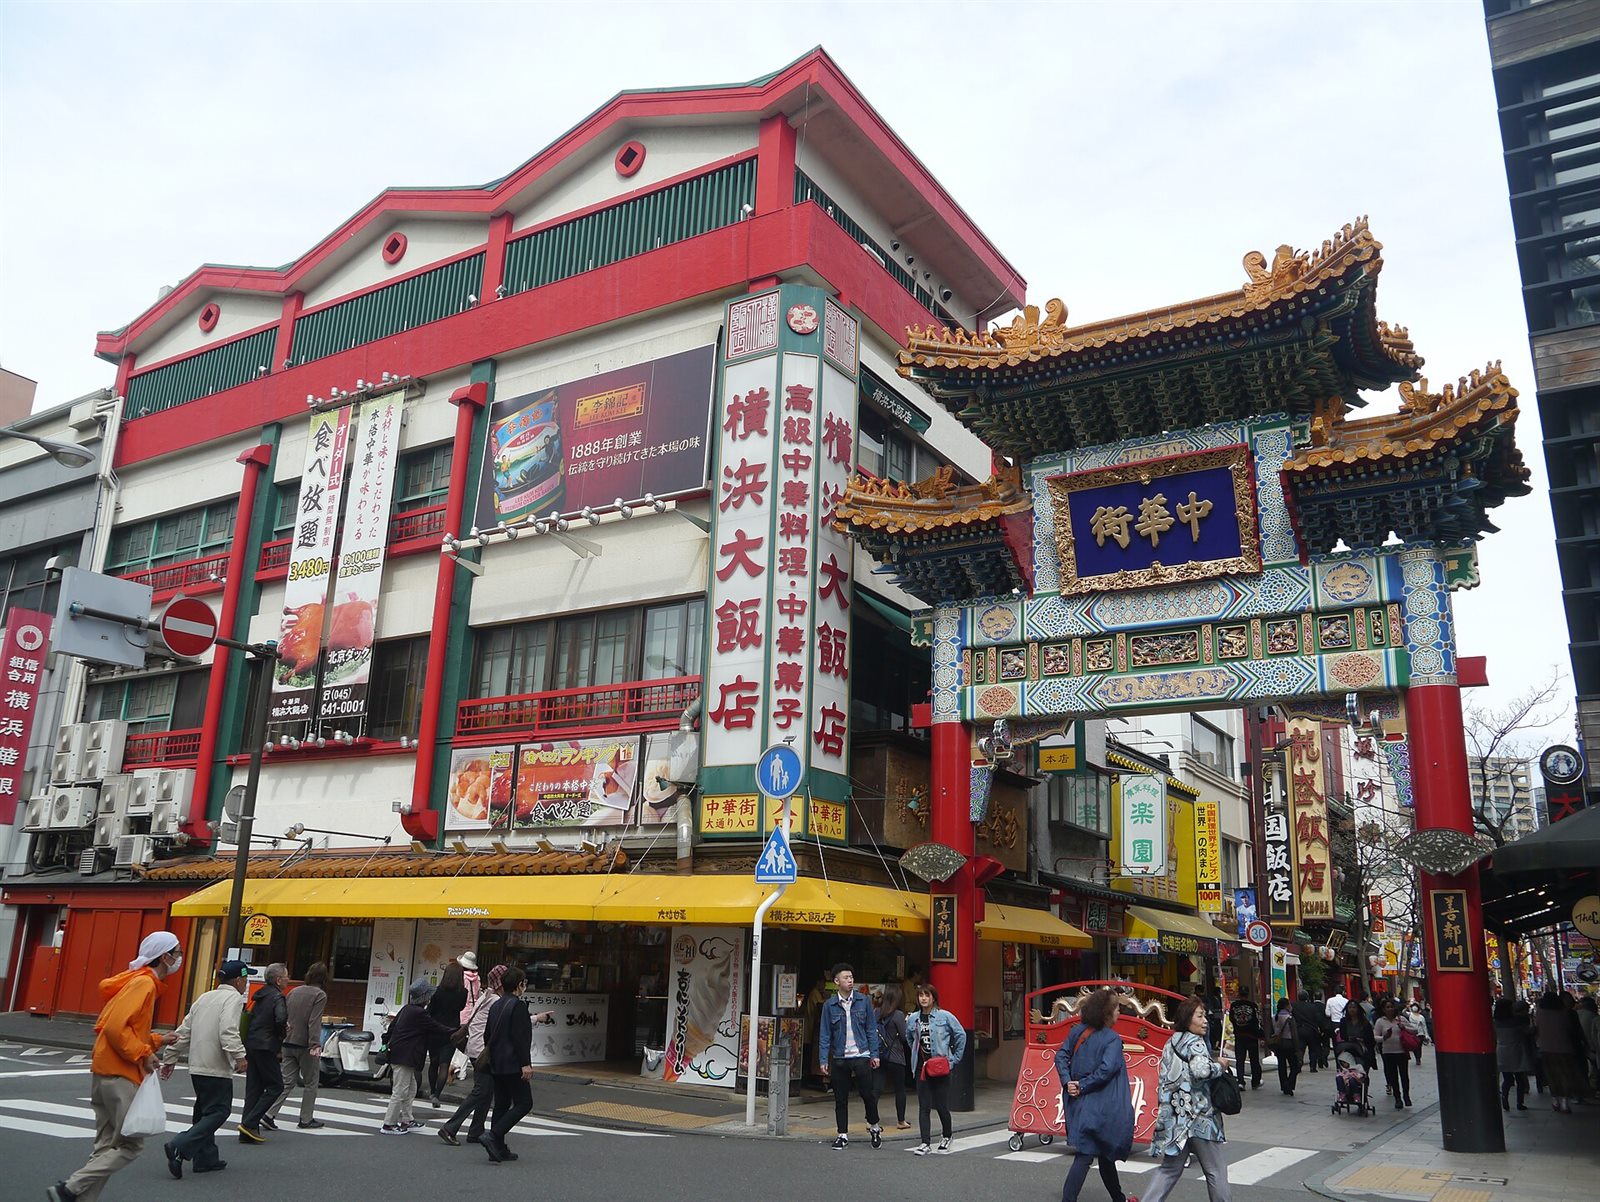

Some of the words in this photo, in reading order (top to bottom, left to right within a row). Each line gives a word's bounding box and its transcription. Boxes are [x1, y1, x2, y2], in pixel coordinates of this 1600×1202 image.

[872, 388, 912, 424] 横浜大飯店
[329, 424, 347, 487] オーダー式
[567, 436, 701, 475] 伝統を守り続けてきた本場の味
[571, 430, 642, 460] 1888年創業
[297, 420, 334, 549] 食べ放題
[354, 408, 380, 541] 本格中華が味わえる
[368, 404, 394, 539] 素材と味にこだわった
[1089, 491, 1214, 549] 中華街
[288, 556, 330, 582] 3,480円
[708, 386, 770, 731] 横浜大飯店
[772, 383, 813, 729] 高級中華料理・中華菓子
[328, 647, 370, 665] 北京ダック
[321, 700, 365, 716] 641-0001
[1045, 754, 1069, 765] 本店
[531, 800, 592, 821] 食べ放題
[706, 798, 756, 816] 中華街
[810, 801, 842, 825] 中華街
[705, 818, 755, 829] 大通り入口
[809, 821, 842, 835] 大通り入口
[1130, 801, 1155, 862] 楽園
[1197, 806, 1208, 879] 世界一の肉まん
[1206, 803, 1218, 881] 中国料理世界チャンピオン
[1199, 891, 1220, 901] 100円
[222, 906, 254, 915] 横飯店
[769, 909, 836, 924] 横浜大飯店
[1162, 935, 1198, 953] 中華街名物の
[1251, 928, 1266, 940] 30
